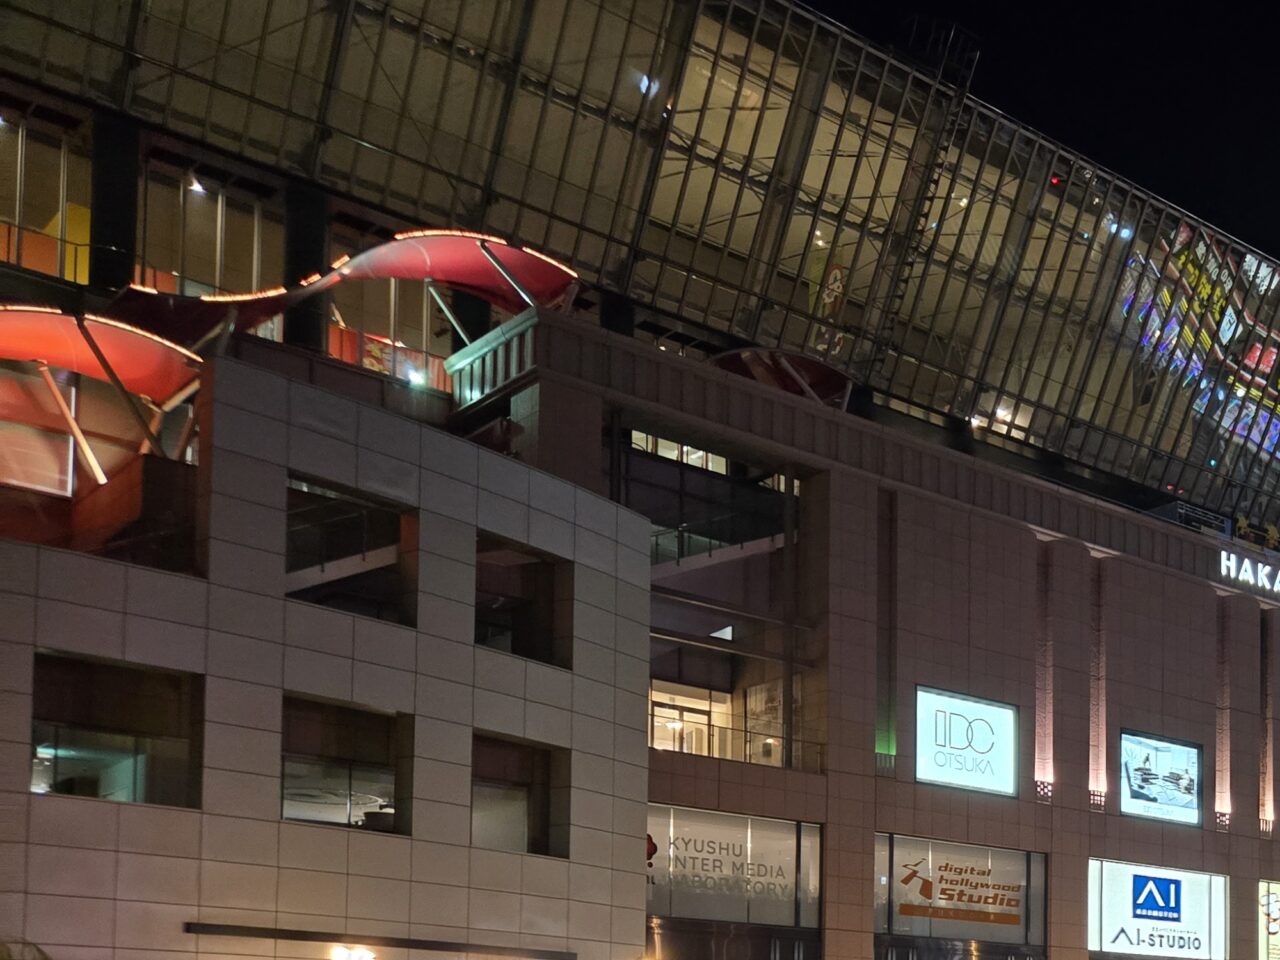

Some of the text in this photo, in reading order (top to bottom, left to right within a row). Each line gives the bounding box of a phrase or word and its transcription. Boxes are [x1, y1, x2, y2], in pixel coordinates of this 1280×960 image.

[935, 709, 995, 755] IDC
[933, 751, 995, 776] OTSUKA
[668, 836, 743, 858] KYUSHU
[668, 854, 786, 880] INTER MEDIA
[938, 862, 992, 877] digital
[938, 874, 1021, 893] hollywood
[1136, 880, 1176, 908] AI
[1111, 926, 1202, 951] AI-STUDIO
